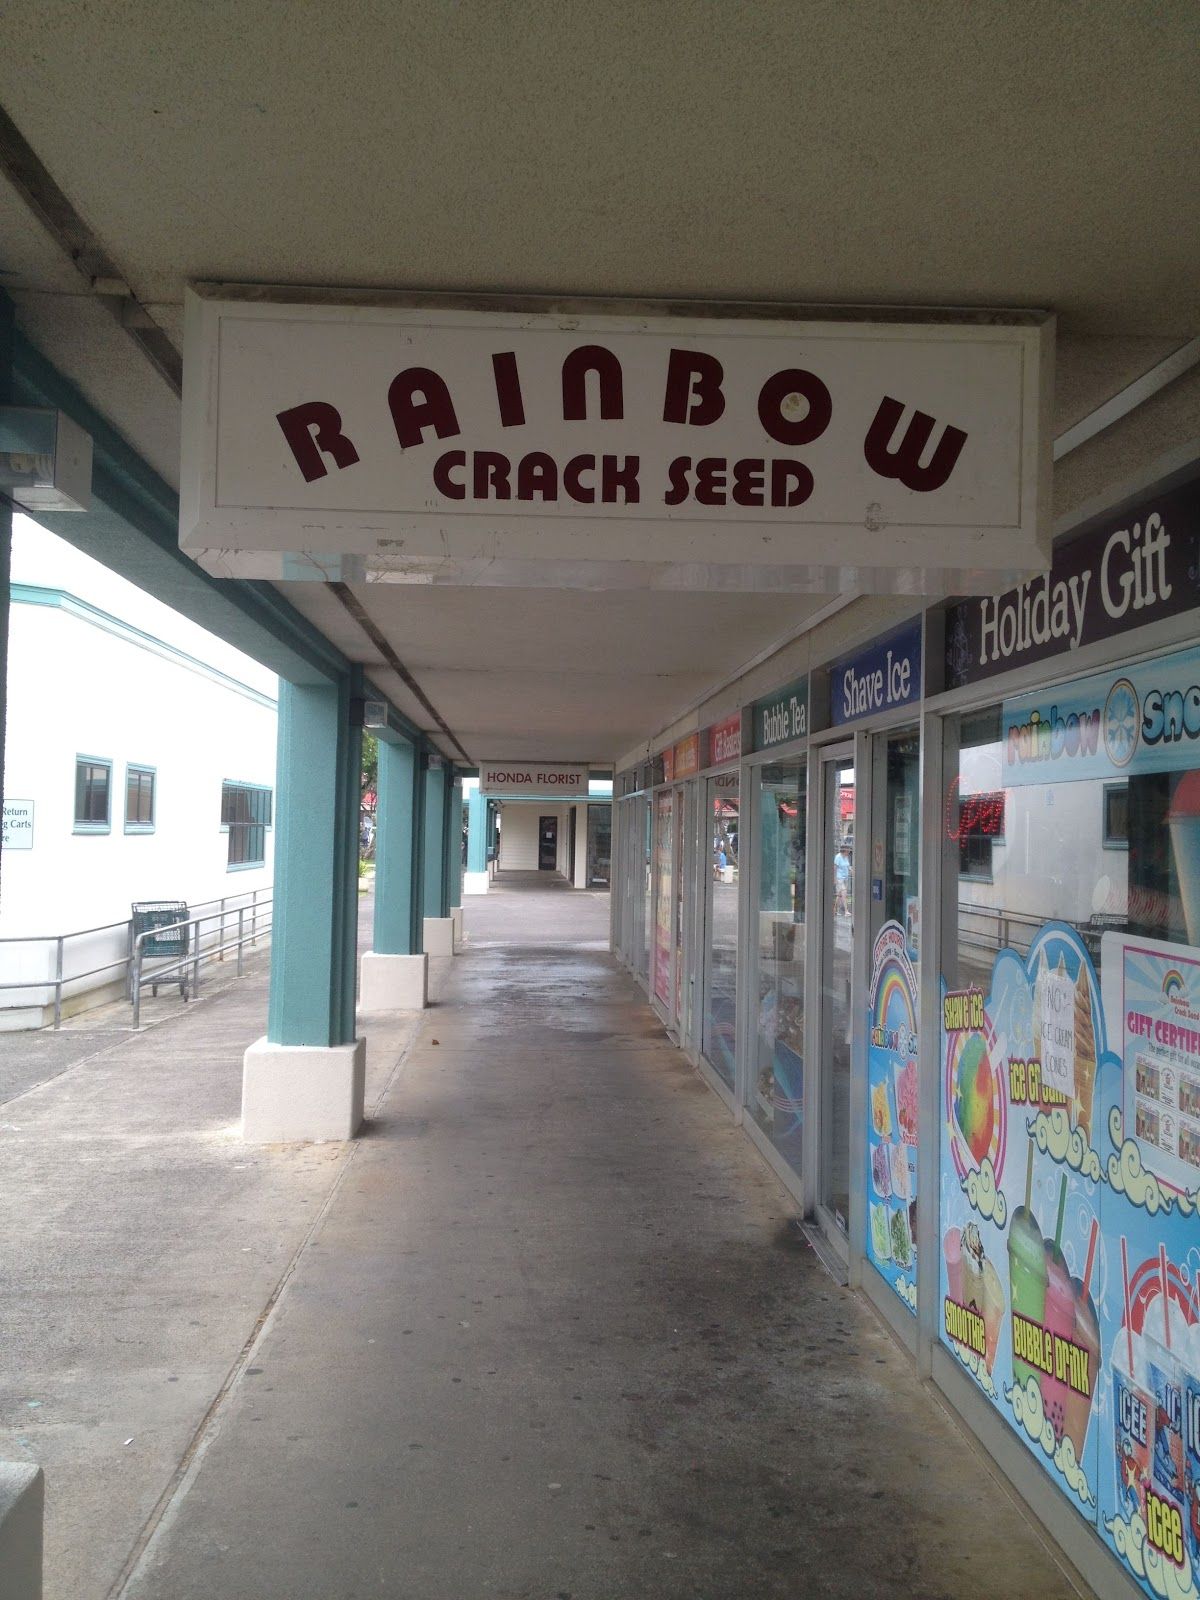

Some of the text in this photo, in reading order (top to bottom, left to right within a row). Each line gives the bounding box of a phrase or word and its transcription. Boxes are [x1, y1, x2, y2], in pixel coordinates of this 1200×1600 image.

[275, 344, 968, 492] RAINBOW
[433, 450, 814, 508] CRACK SEED
[979, 512, 1172, 665] Holiday Gift
[843, 650, 911, 718] Shave Ice
[763, 696, 806, 745] Bubble Tea
[487, 772, 581, 784] HONDA FLORIST
[10, 819, 32, 829] Carts
[1127, 1011, 1153, 1039] GIFT
[1118, 1384, 1148, 1447] ICEE
